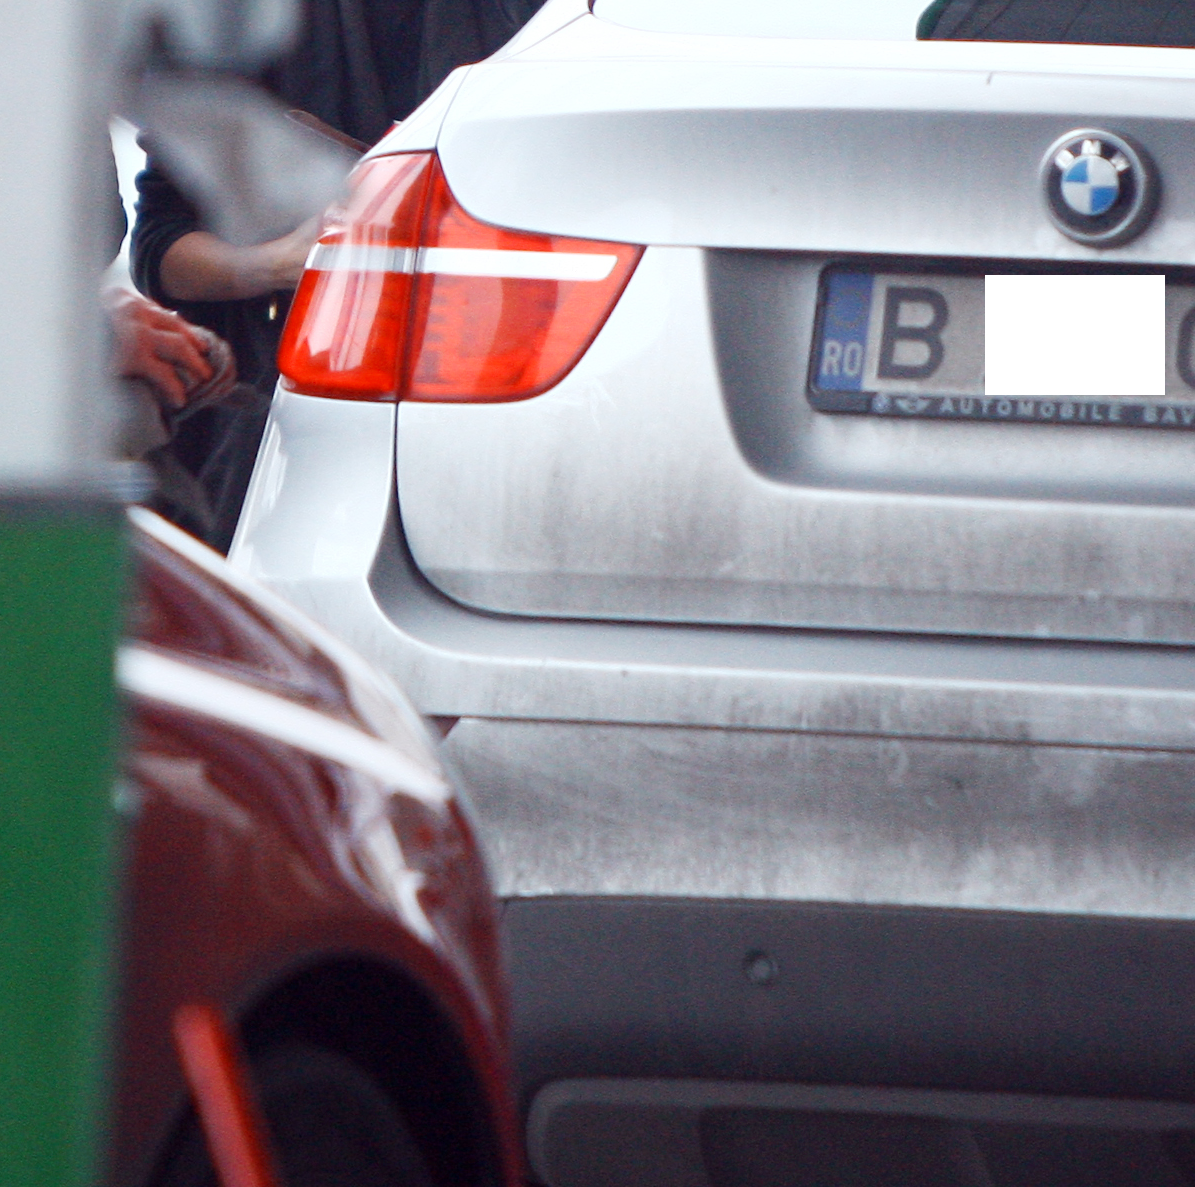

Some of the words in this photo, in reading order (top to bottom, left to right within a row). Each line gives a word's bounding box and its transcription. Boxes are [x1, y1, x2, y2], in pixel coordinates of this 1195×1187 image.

[876, 285, 949, 380] B
[821, 340, 864, 377] RO
[939, 398, 1122, 421] AUTOMOBILE
